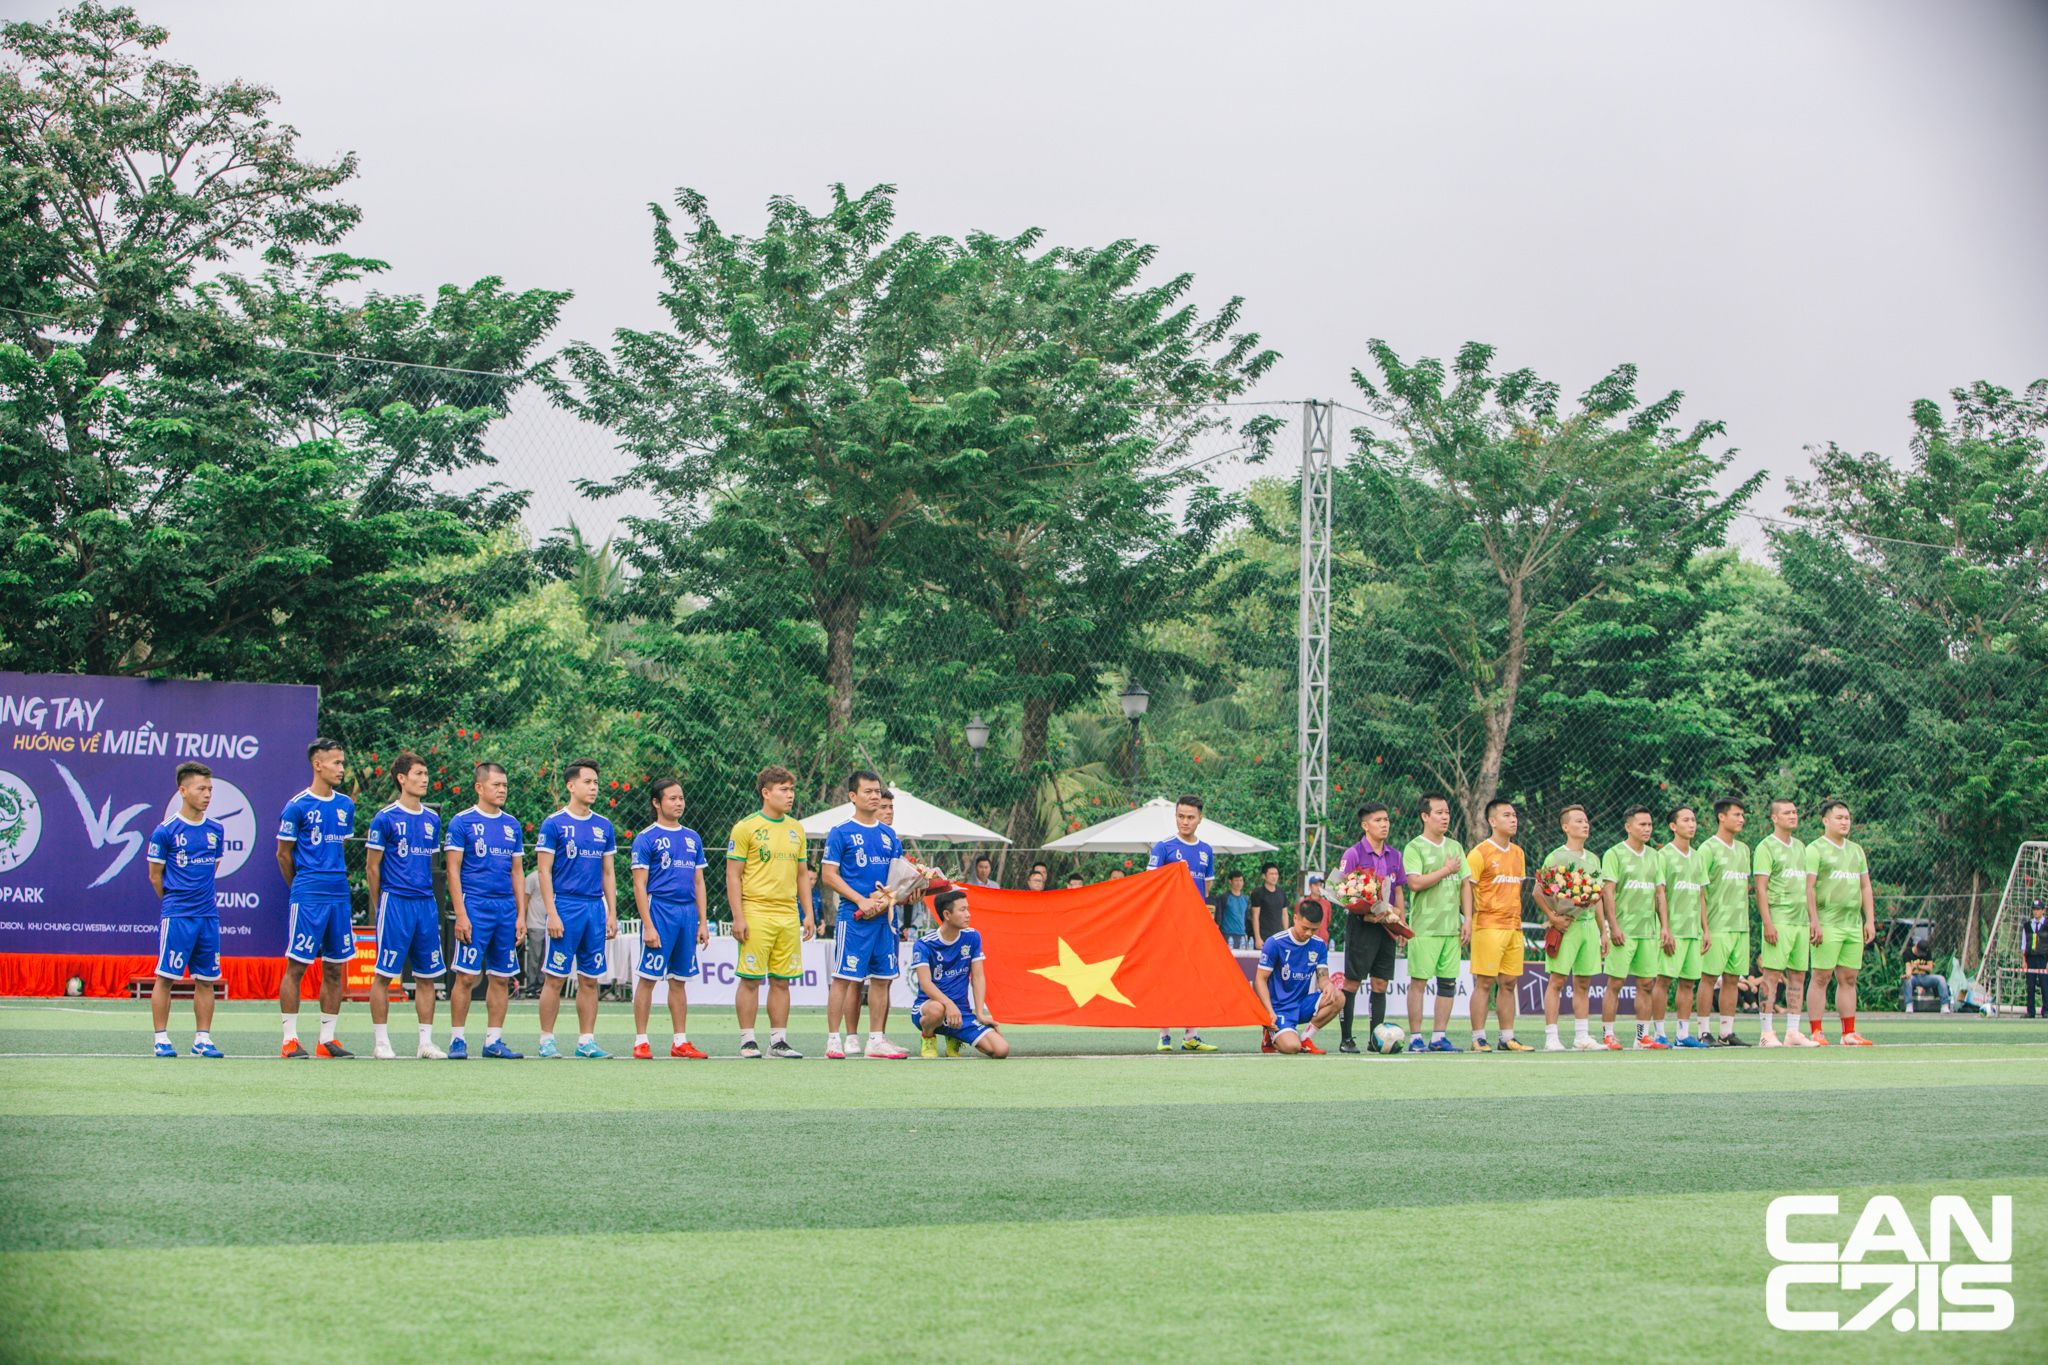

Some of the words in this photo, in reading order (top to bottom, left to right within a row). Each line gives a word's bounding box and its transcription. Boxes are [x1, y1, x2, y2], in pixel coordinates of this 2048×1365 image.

[0, 695, 48, 731] NG
[50, 697, 104, 732] TAY
[13, 731, 75, 752] HƯỚNG
[80, 731, 102, 753] VỀ
[102, 720, 169, 756] MIỀN
[175, 732, 259, 760] TRUNG
[307, 809, 322, 824] 92
[396, 822, 407, 836] 17
[472, 823, 485, 836] 19
[562, 826, 575, 838] 77
[755, 829, 769, 841] 32
[175, 833, 187, 847] 16
[655, 836, 671, 850] 20
[850, 833, 865, 847] 18
[1175, 849, 1183, 860] 6
[214, 892, 260, 909] ZUNO
[28, 922, 43, 931] KHU
[43, 922, 72, 932] CHUNG
[133, 924, 159, 933] ECOPA
[294, 933, 315, 954] 24
[169, 950, 183, 969] 16
[382, 949, 398, 968] 17
[462, 945, 478, 965] 19
[645, 953, 664, 971] 20
[1284, 949, 1291, 962] 7
[702, 962, 735, 985] FC
